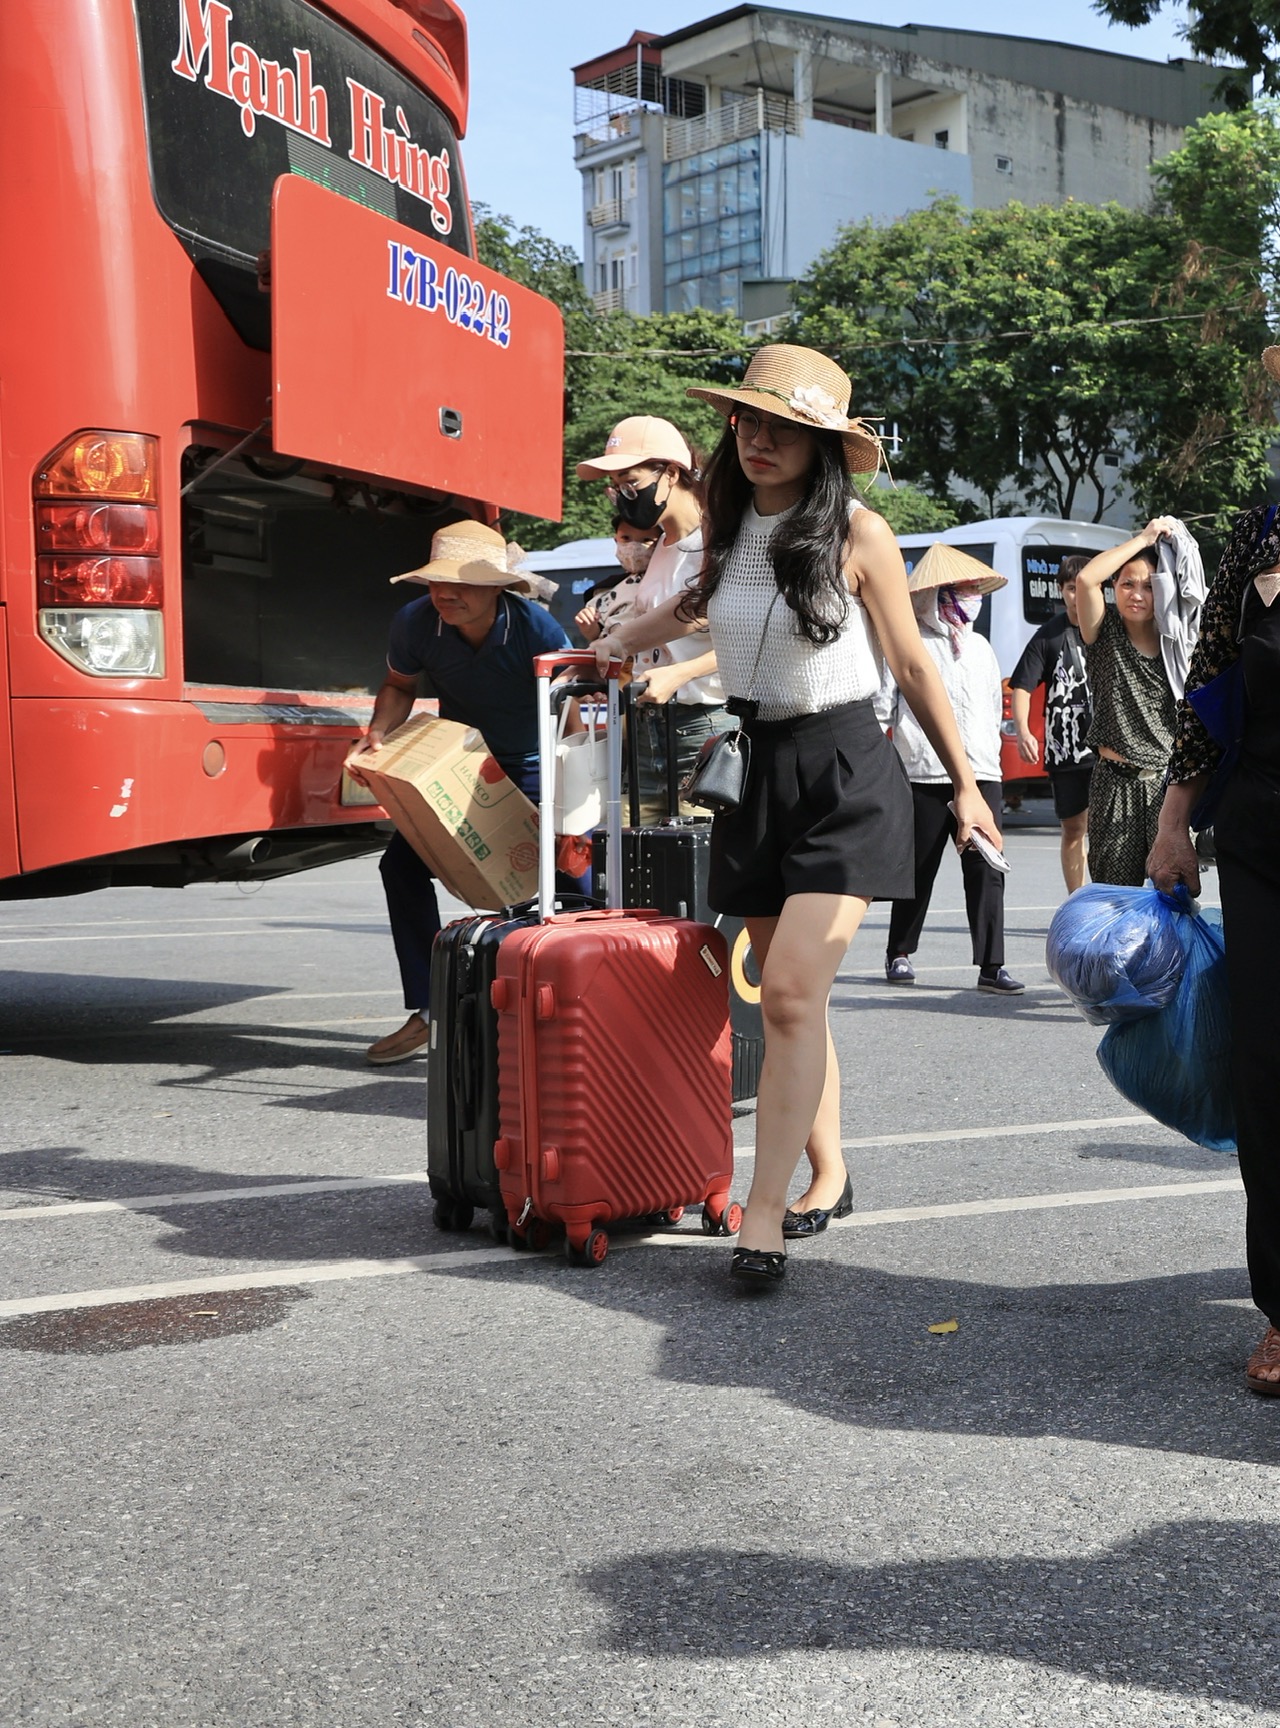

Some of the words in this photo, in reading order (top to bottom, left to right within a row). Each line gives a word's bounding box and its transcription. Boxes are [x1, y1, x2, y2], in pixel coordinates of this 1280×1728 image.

[172, 0, 332, 147] Mạnh
[346, 77, 453, 235] Hùng
[387, 240, 511, 348] 17B-02242
[1026, 558, 1047, 574] Nhà
[1029, 577, 1047, 597] GIÁP
